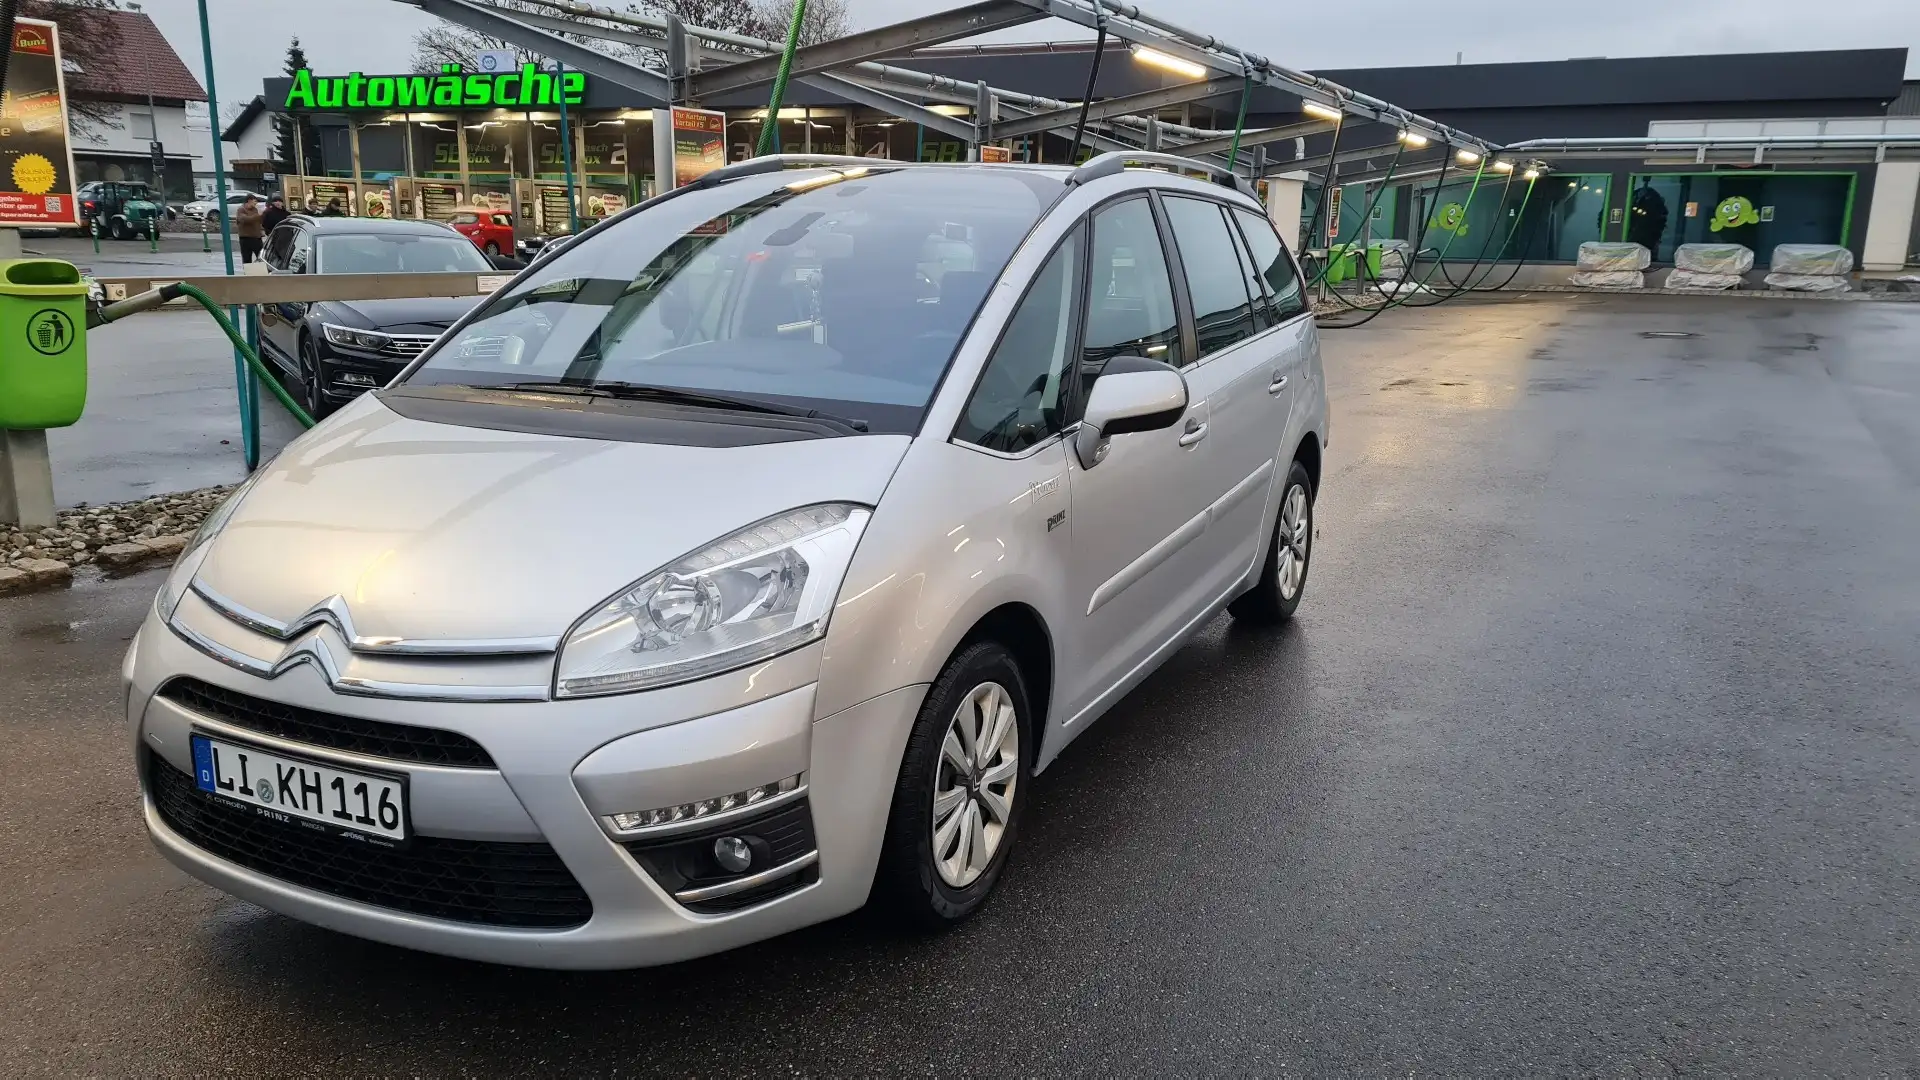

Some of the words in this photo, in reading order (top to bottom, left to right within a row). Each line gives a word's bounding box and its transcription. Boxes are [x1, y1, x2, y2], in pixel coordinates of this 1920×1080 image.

[284, 63, 584, 107] Autowäsche
[865, 141, 885, 160] 4
[213, 747, 254, 796] LI
[257, 808, 290, 823] PRINZ
